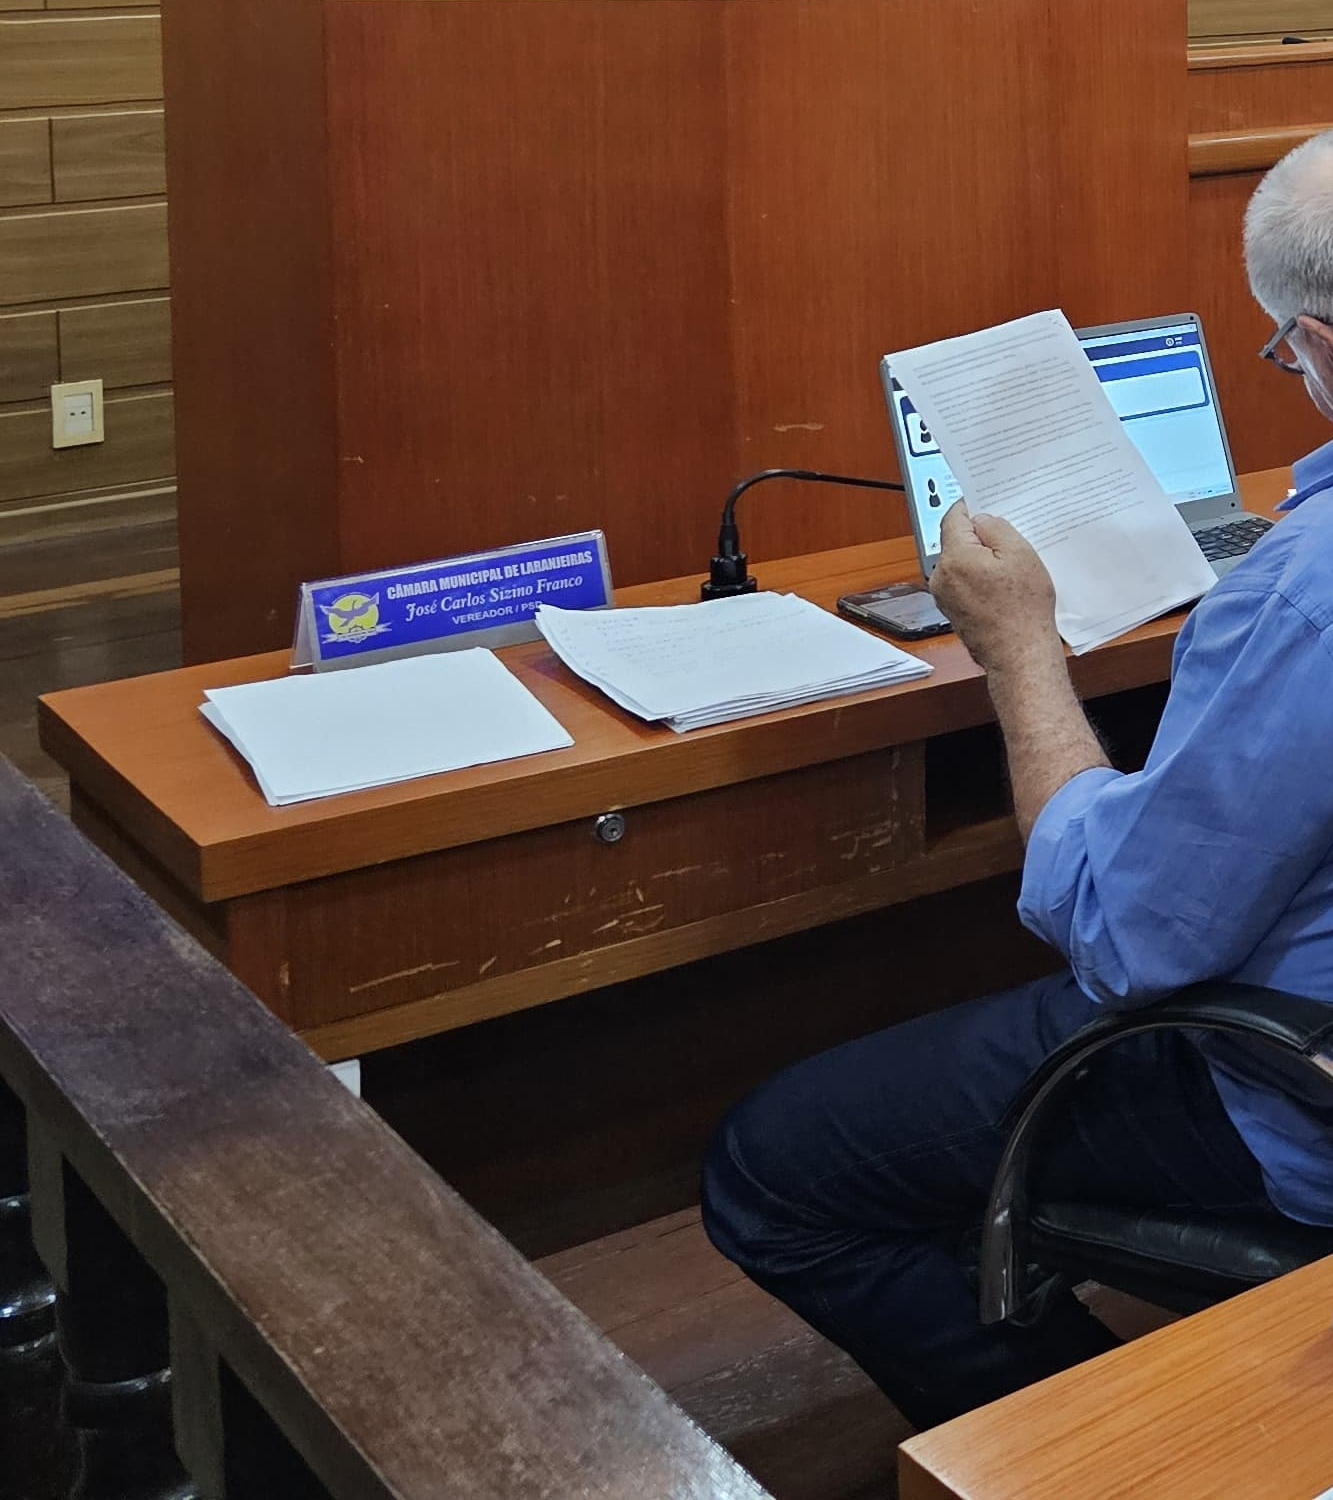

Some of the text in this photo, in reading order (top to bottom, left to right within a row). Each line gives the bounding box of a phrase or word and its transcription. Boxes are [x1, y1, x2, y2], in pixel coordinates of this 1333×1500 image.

[386, 550, 593, 600] CÂMARA MUNICIPAL DE LARANJEIRAS
[405, 575, 584, 622] José Carlos Sizino Franco
[452, 605, 514, 625] VEREADOR
